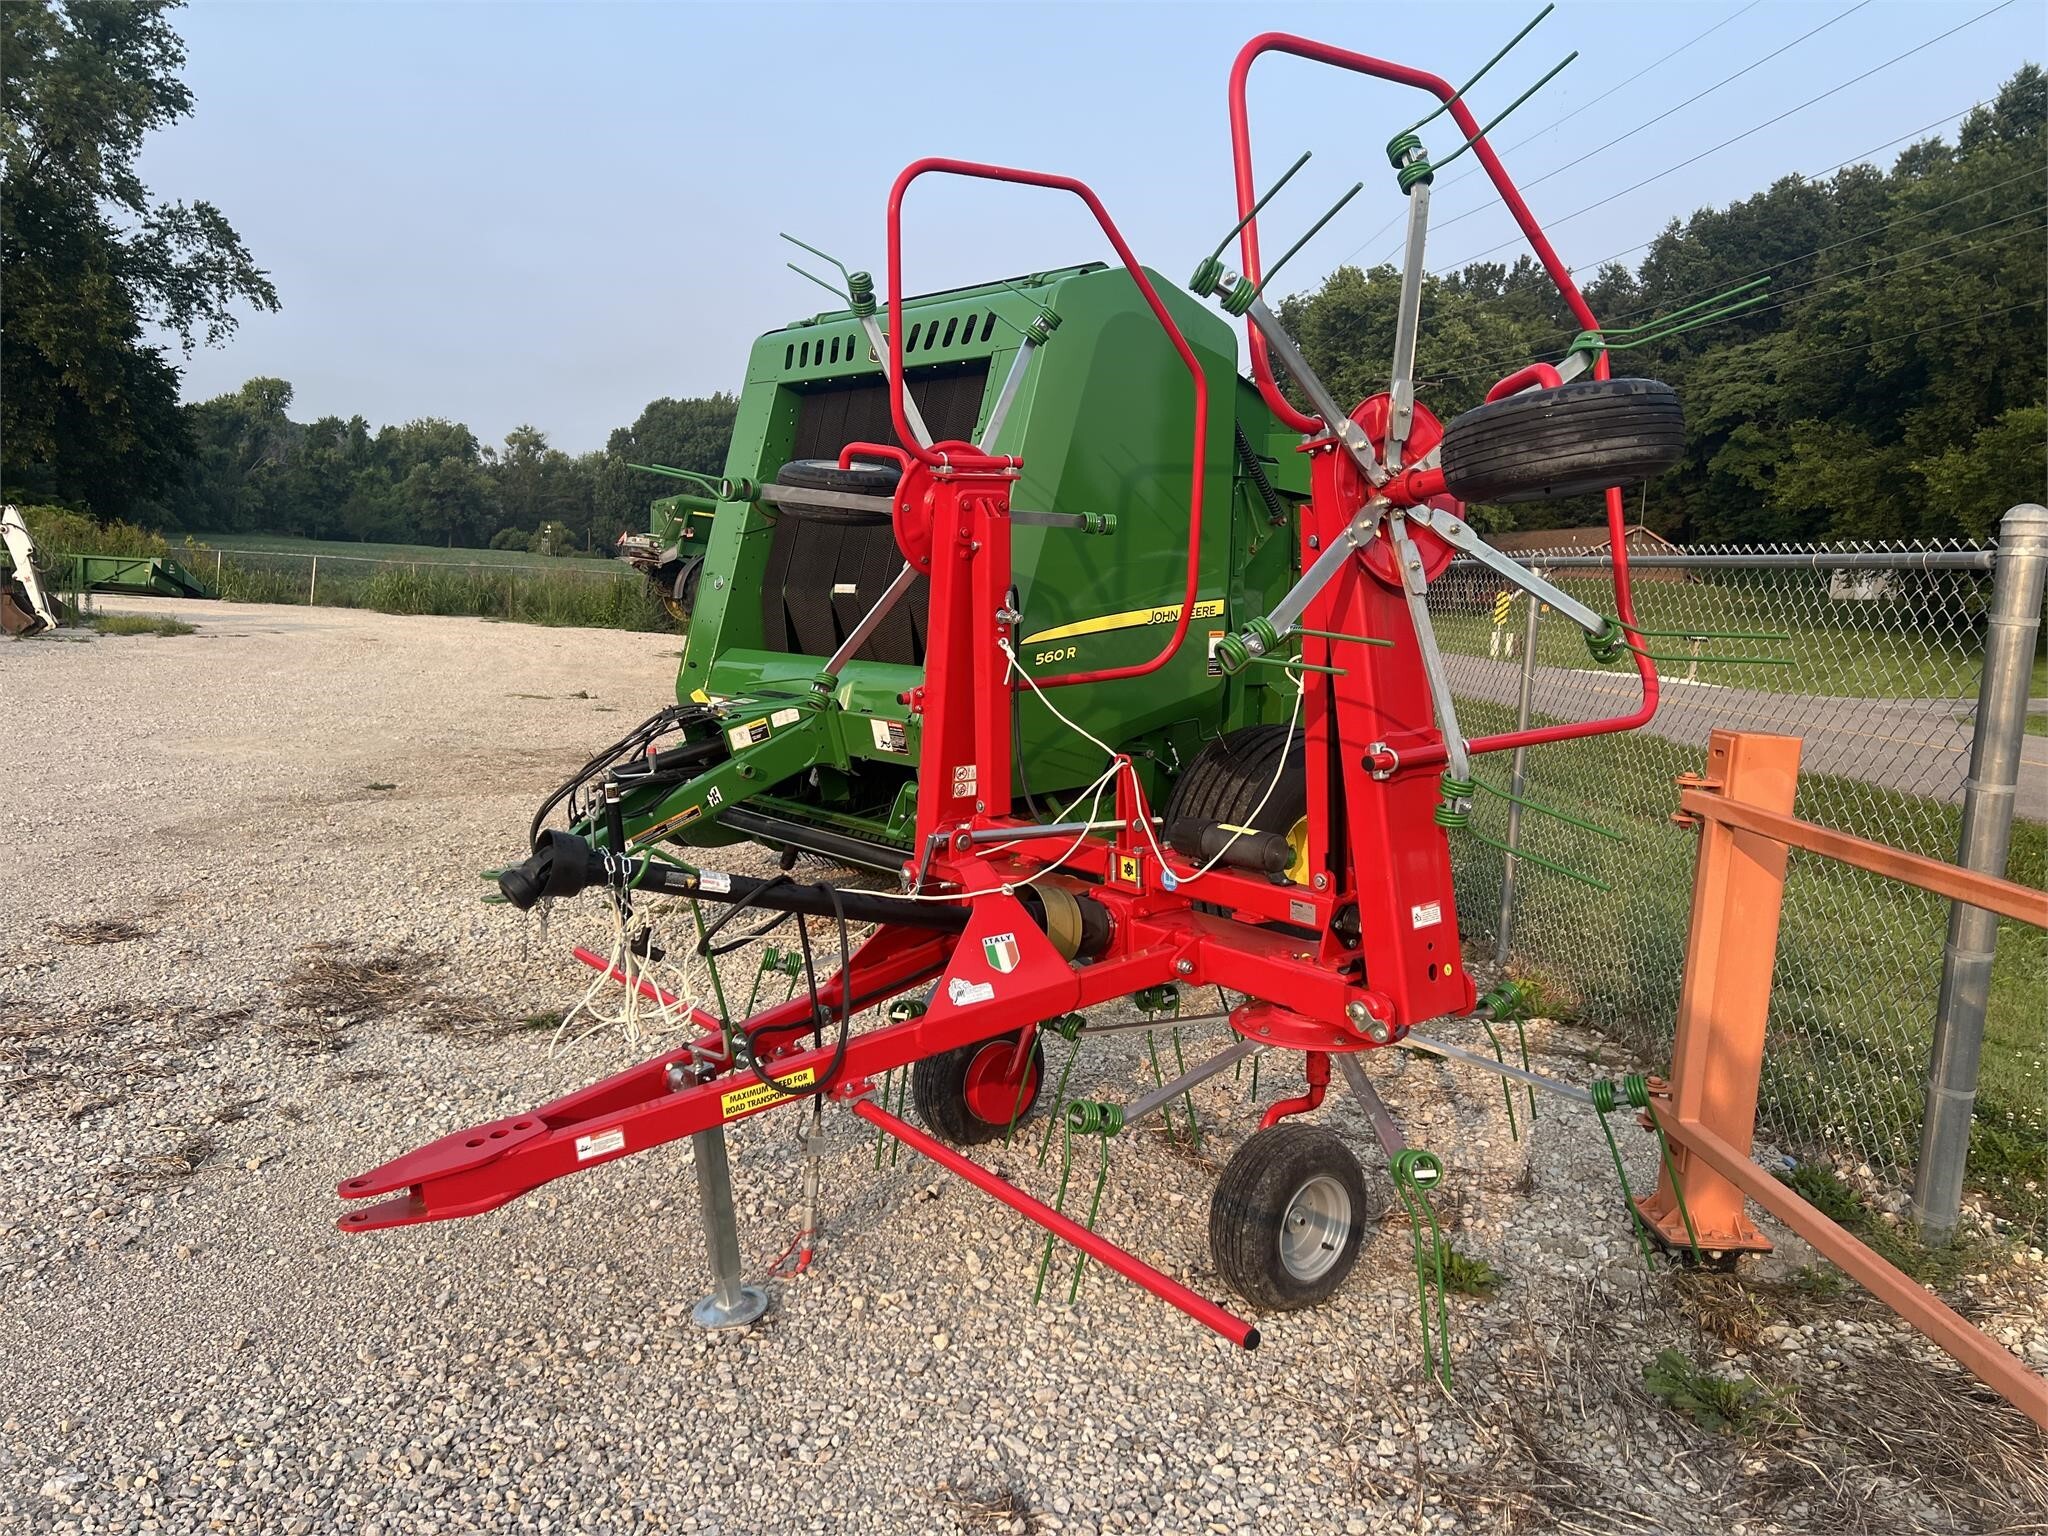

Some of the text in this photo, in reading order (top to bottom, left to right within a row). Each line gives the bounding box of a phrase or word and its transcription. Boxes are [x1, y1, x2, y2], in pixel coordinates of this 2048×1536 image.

[1147, 610, 1178, 623] JOHN
[1035, 647, 1076, 665] 560 R
[984, 934, 1010, 945] ITALY
[730, 1086, 769, 1103] MAXIMUM
[794, 1072, 808, 1083] FOR
[726, 1103, 745, 1115] ROAD
